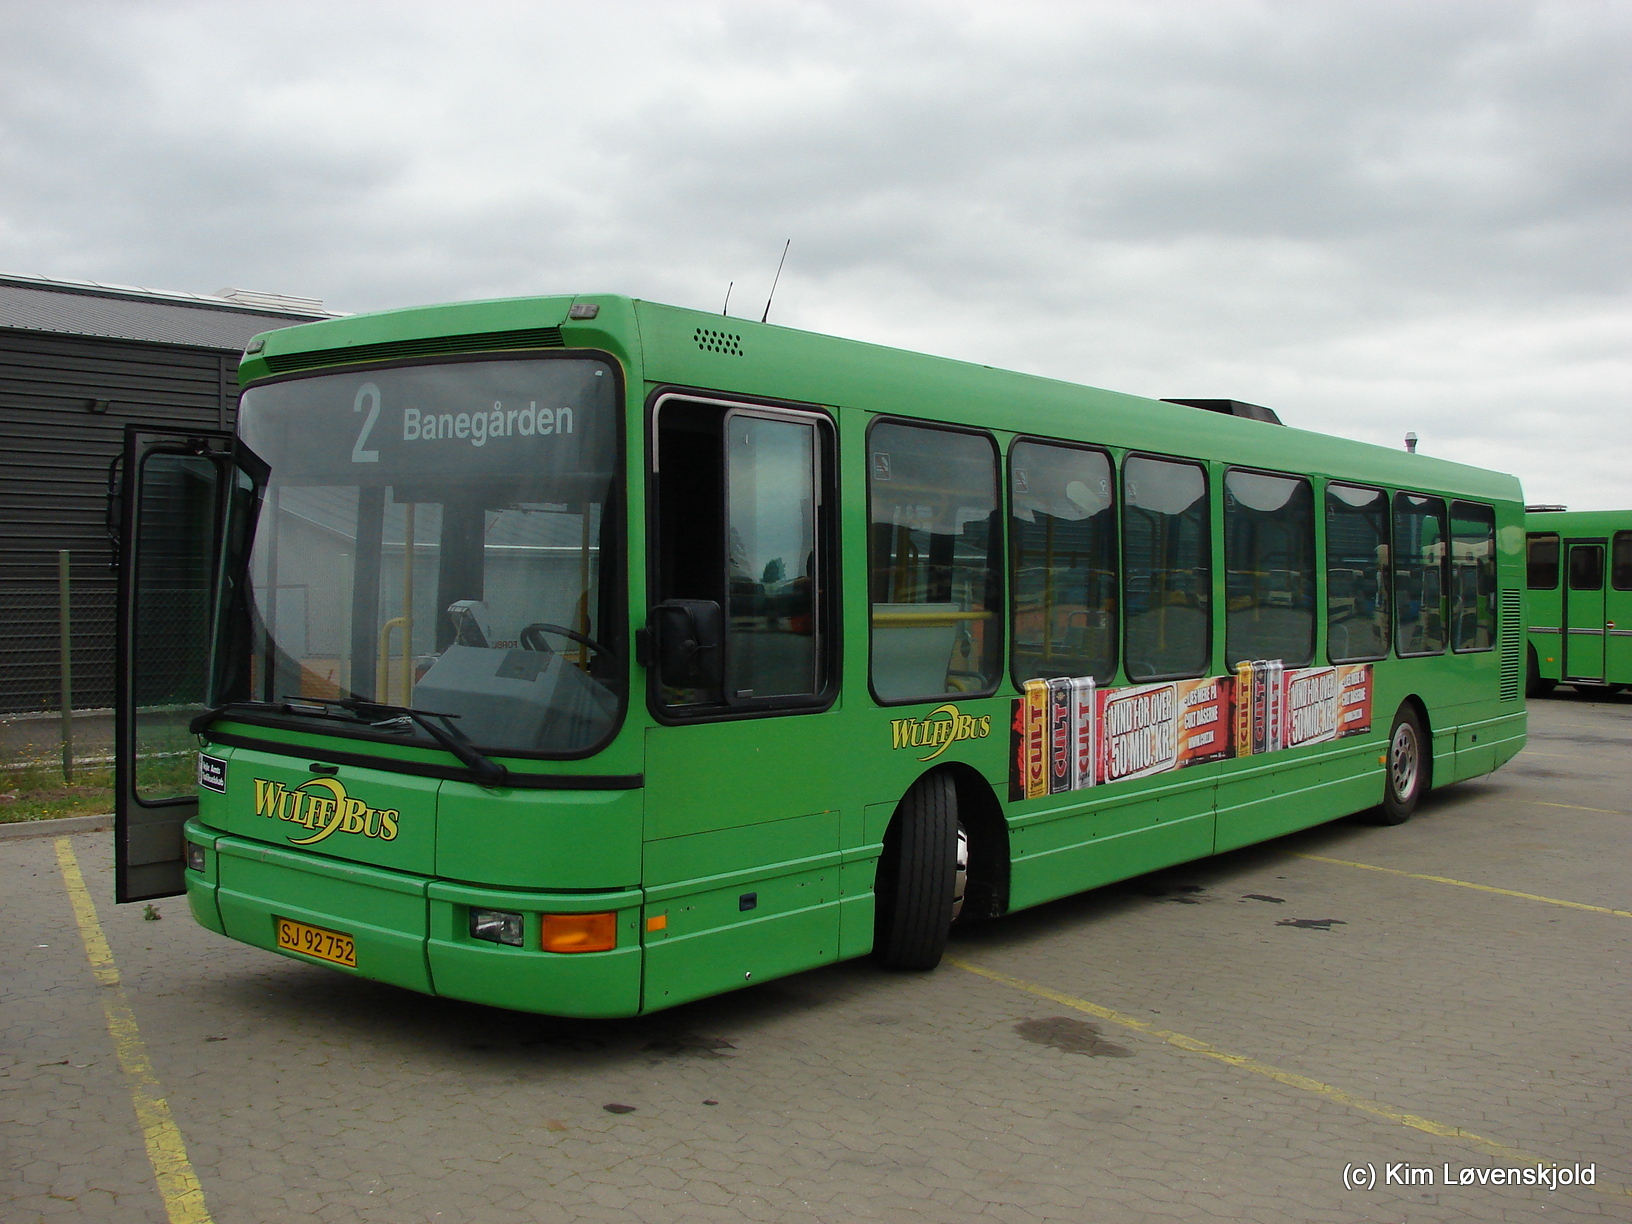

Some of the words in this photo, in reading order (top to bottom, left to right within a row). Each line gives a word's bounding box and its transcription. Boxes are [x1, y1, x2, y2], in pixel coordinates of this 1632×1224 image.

[351, 382, 381, 463] 2
[403, 400, 573, 447] Banegården
[1078, 702, 1090, 773] CULT
[1110, 701, 1132, 737] VIND
[1133, 697, 1149, 730] FOR
[1151, 690, 1172, 725] OVER
[1240, 682, 1249, 742] CULT
[1270, 681, 1279, 738] CULT
[1031, 705, 1043, 780] CULT
[1054, 703, 1067, 778] CULT
[1112, 735, 1127, 777] 50
[281, 922, 300, 947] SJ
